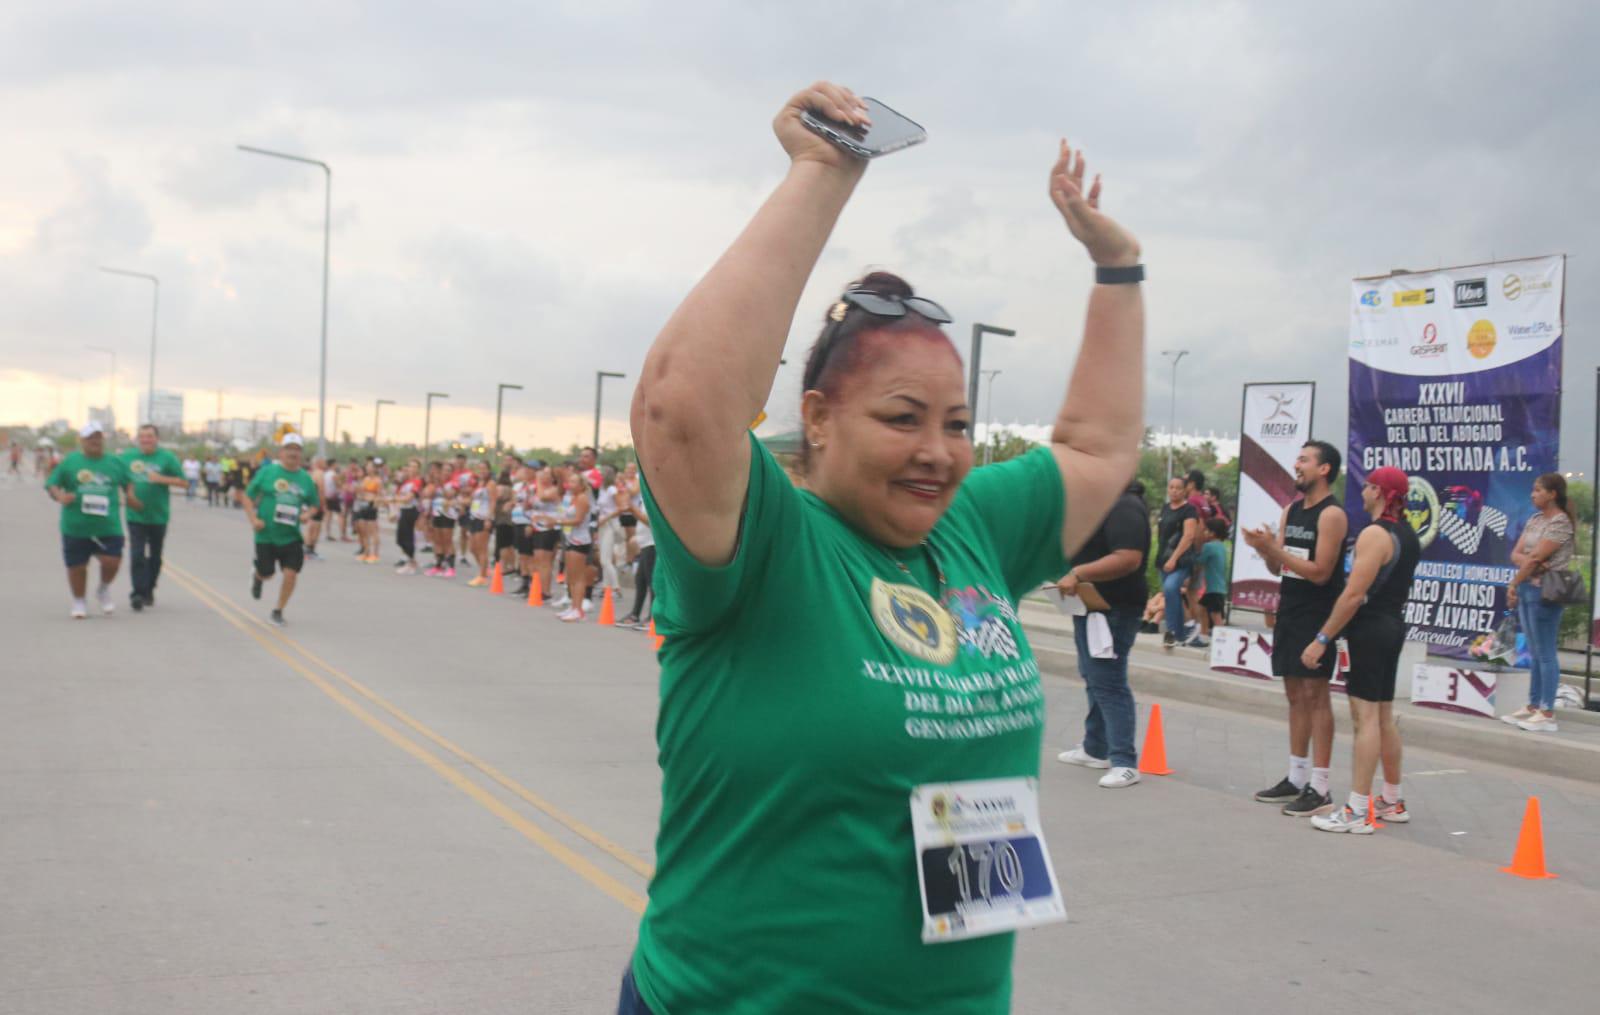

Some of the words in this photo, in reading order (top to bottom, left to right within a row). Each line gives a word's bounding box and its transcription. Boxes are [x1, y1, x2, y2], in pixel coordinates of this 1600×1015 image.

[1418, 382, 1464, 405] XXXVII
[1384, 407, 1431, 425] CARRERA
[1434, 404, 1504, 423] TRADICIONAL
[1260, 423, 1298, 435] IMDEM
[1387, 427, 1407, 443] DEL
[1430, 426, 1450, 442] DEL
[1452, 424, 1502, 442] ABOGADO
[1363, 447, 1422, 471] GENARO
[1427, 446, 1495, 471] ESTRADA
[1499, 446, 1533, 471] A.C.
[1443, 581, 1496, 608] ALONSO
[1237, 636, 1249, 666] 2
[1447, 672, 1458, 701] 3
[948, 840, 1024, 901] 170
